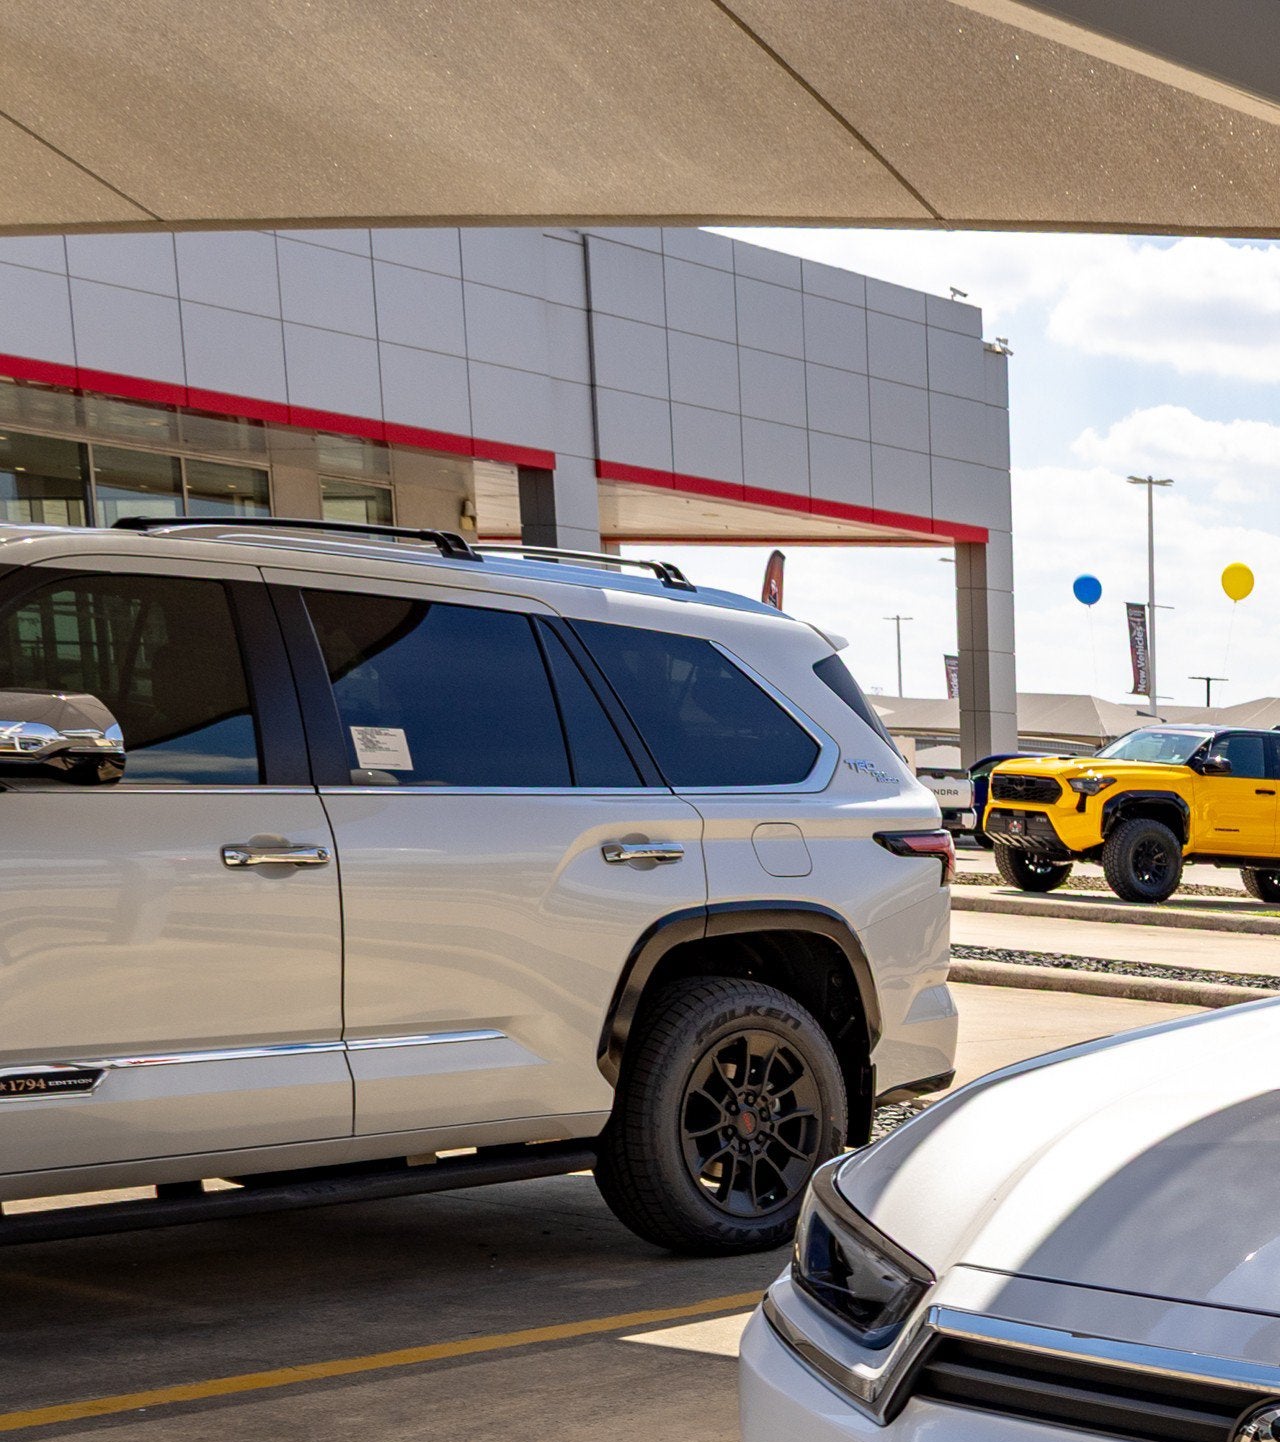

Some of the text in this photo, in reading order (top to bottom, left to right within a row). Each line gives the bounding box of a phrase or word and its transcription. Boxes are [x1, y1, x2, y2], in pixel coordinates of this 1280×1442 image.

[1138, 670, 1146, 692] New
[9, 1078, 93, 1091] 1794 EDITION
